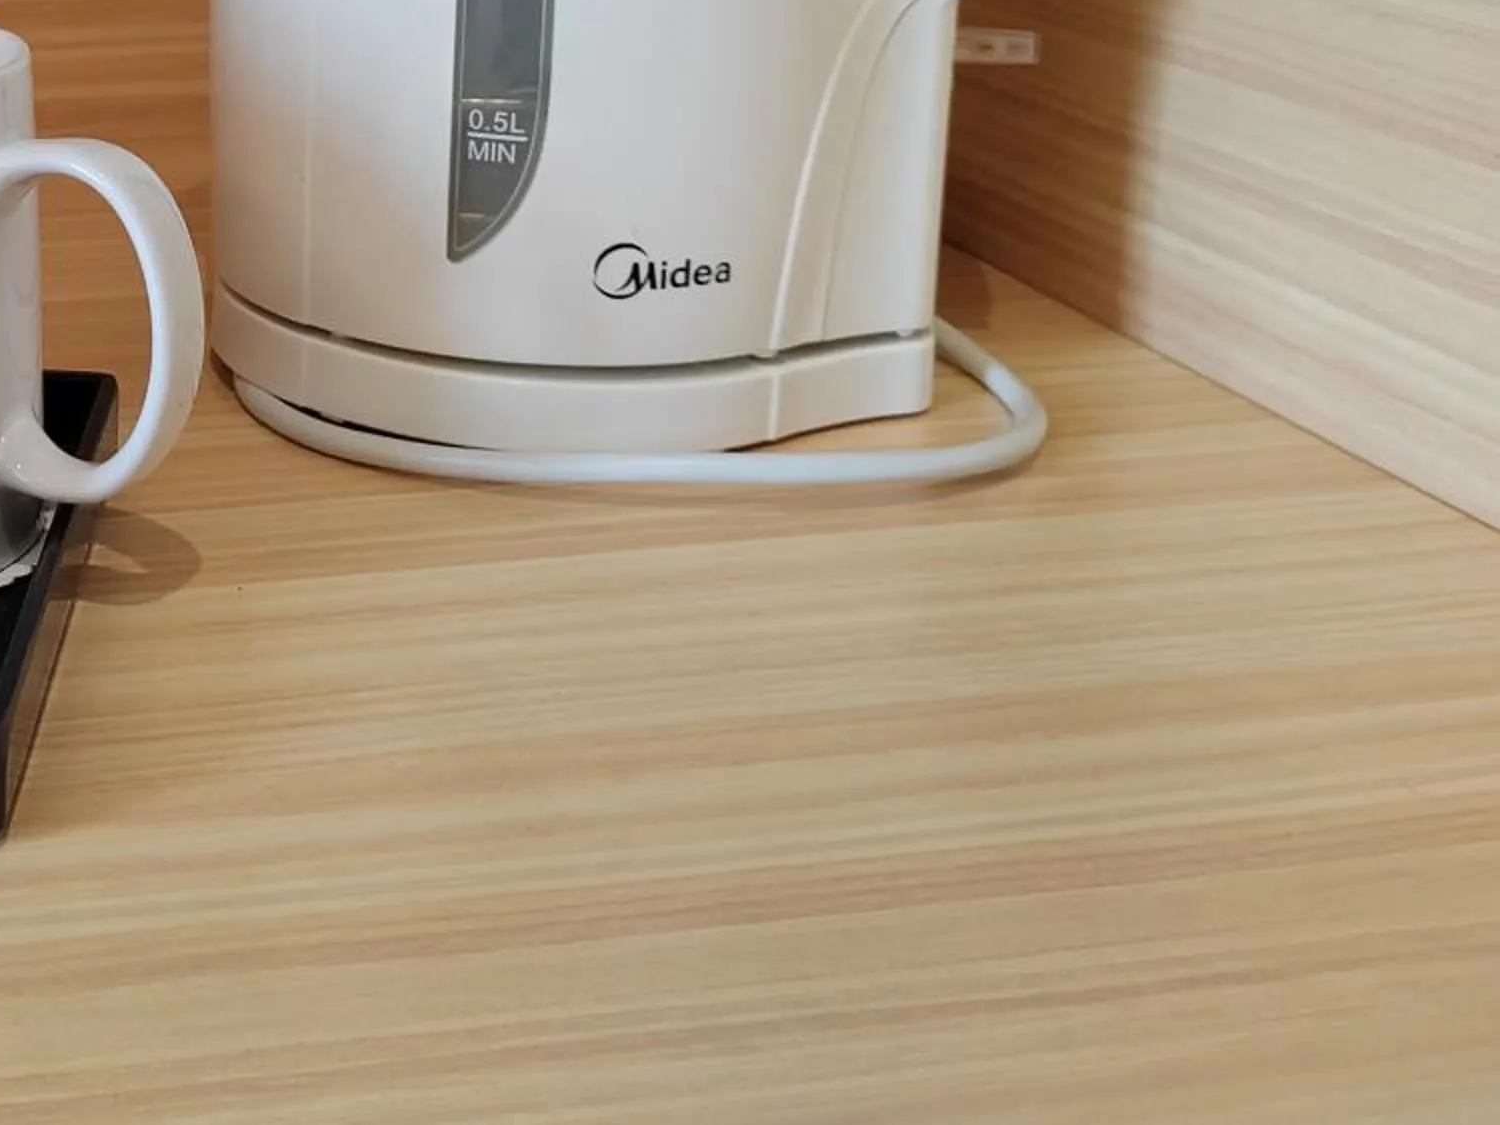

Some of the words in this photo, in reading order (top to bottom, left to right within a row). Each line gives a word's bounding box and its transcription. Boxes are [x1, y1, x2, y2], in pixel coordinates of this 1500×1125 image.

[468, 108, 525, 134] 0.5L
[467, 140, 516, 164] MIN
[592, 242, 732, 300] Midea
